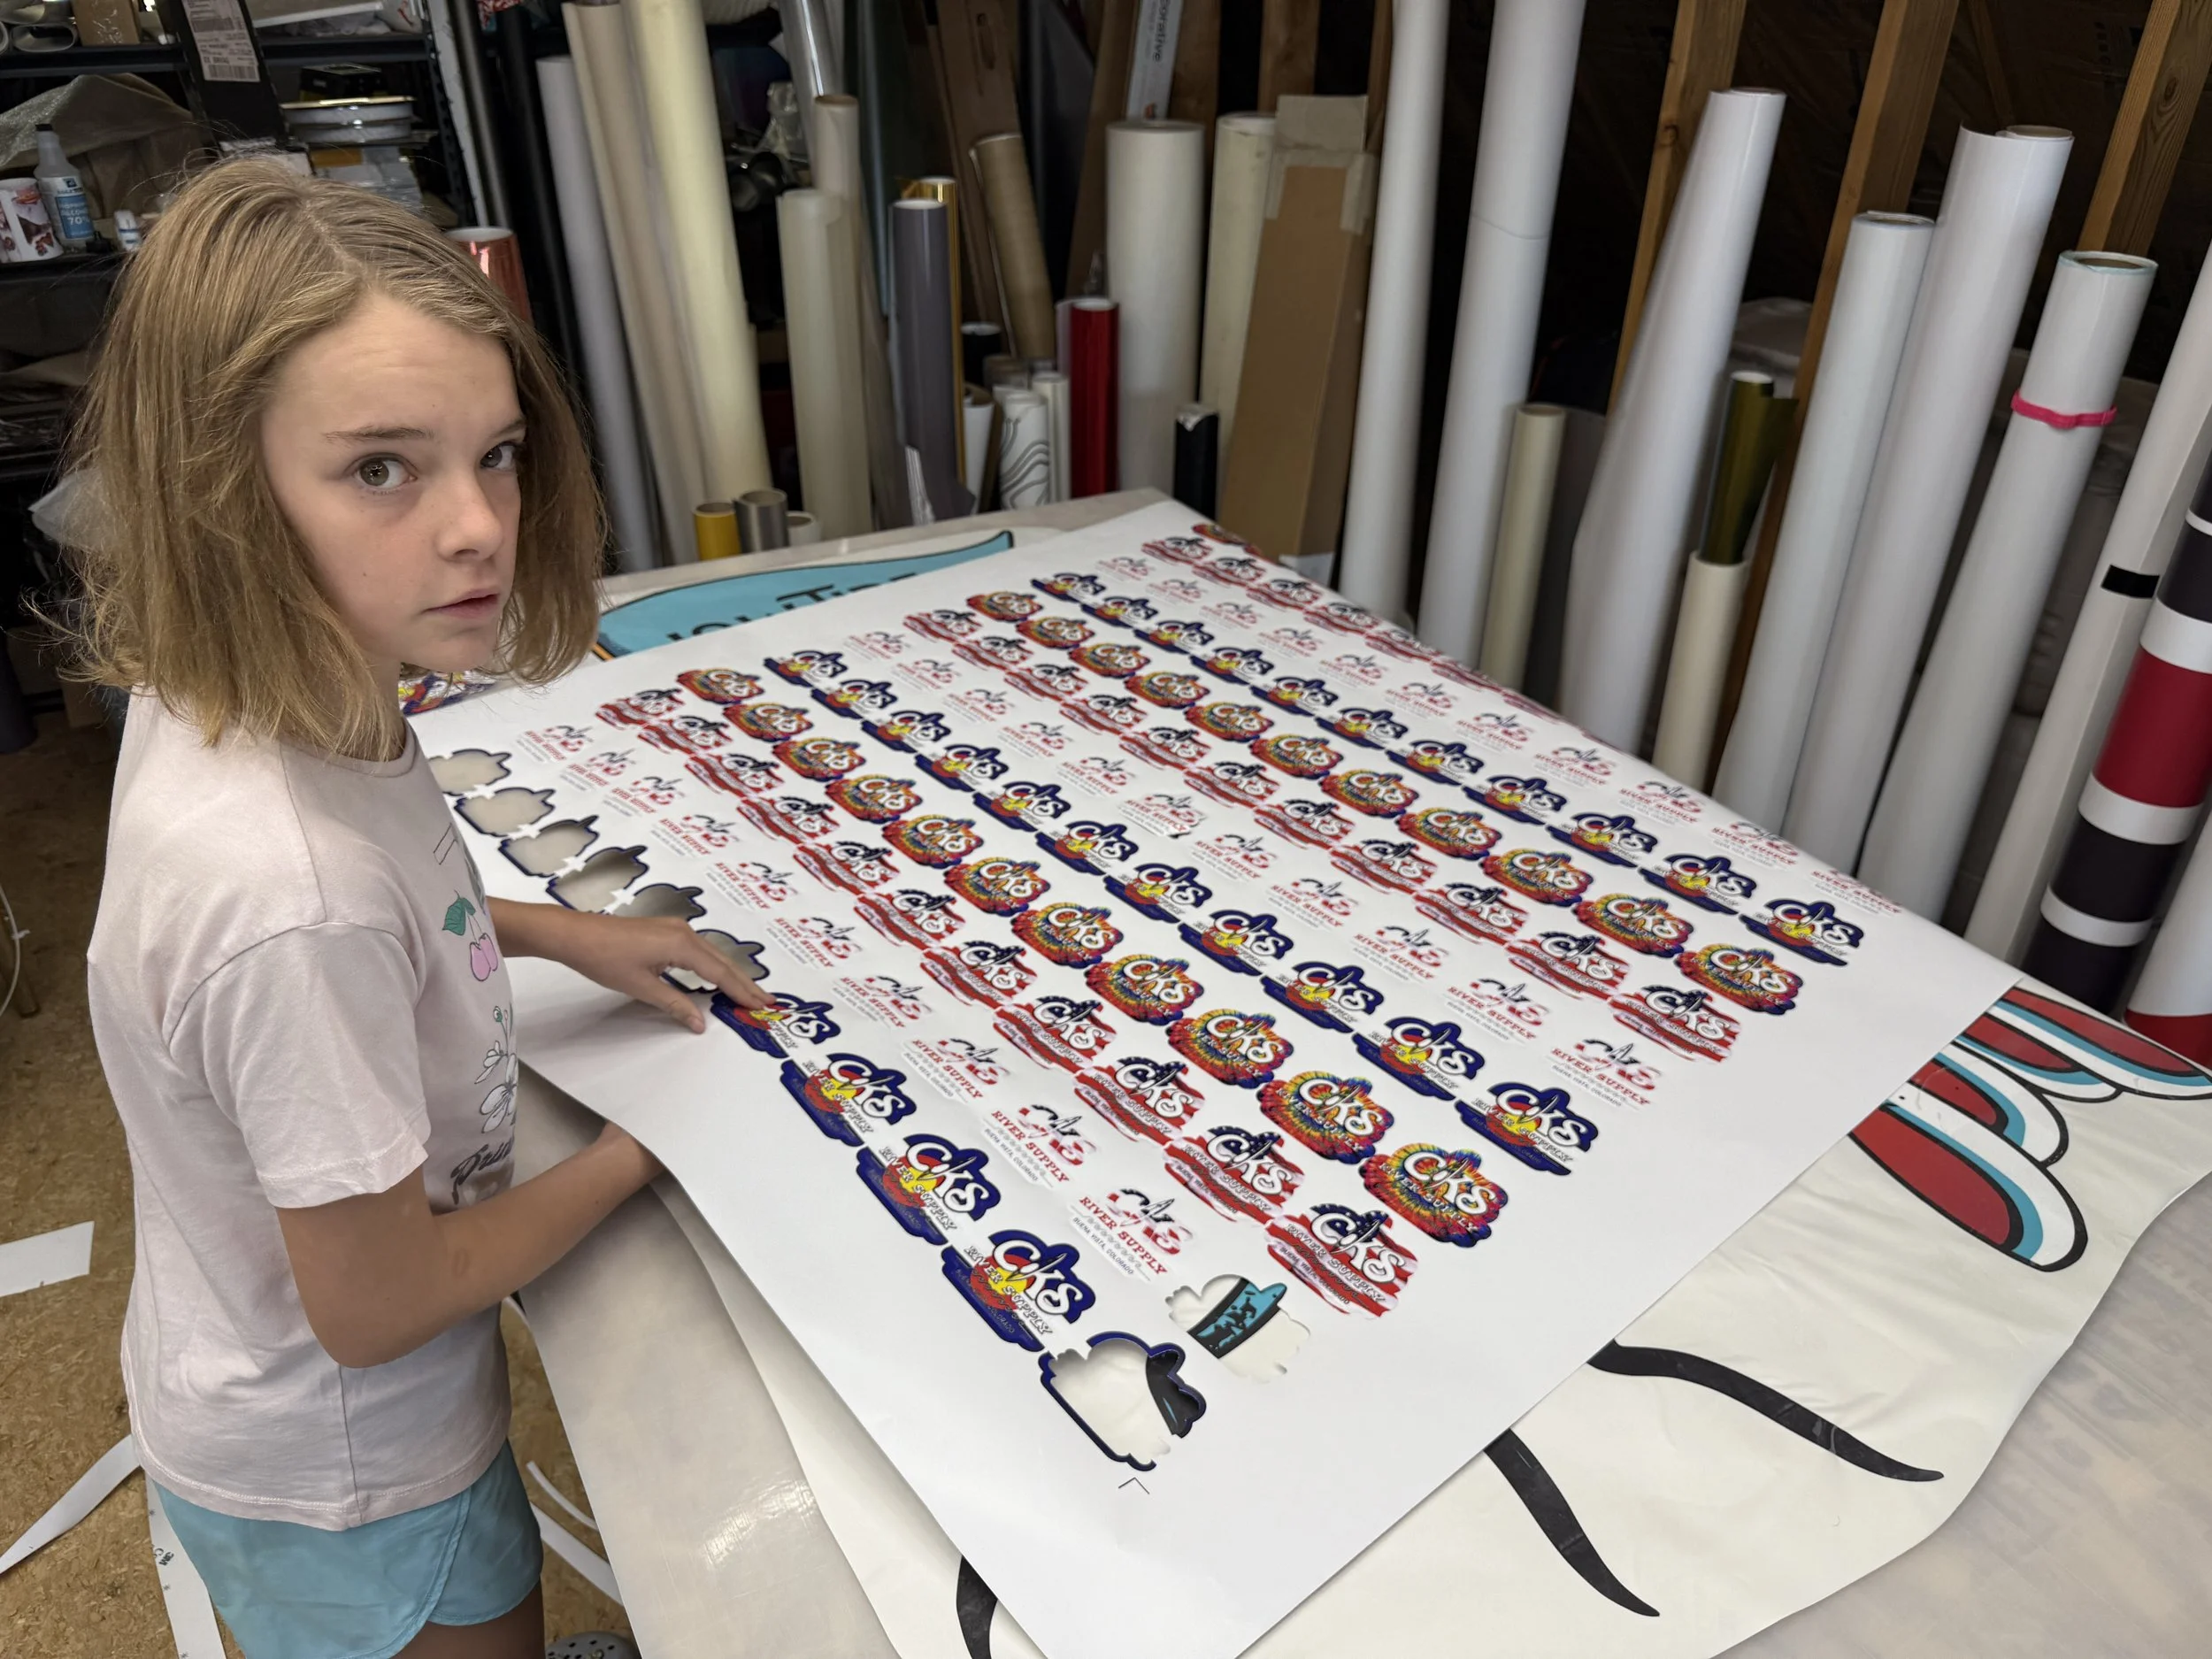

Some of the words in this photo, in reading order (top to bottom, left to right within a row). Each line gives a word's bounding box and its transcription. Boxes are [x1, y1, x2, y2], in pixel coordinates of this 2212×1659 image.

[1672, 858, 1751, 895] CKS
[1215, 915, 1286, 956] CKS
[1603, 897, 1687, 938] CKS
[1774, 904, 1857, 945] CKS
[1121, 957, 1197, 1003] CKS
[1299, 967, 1377, 1010] CKS
[1540, 937, 1624, 981] CKS
[1707, 948, 1797, 993] CKS
[1204, 1013, 1286, 1064] CKS
[1447, 986, 1486, 1010] RIVER
[1486, 1009, 1535, 1041] SUPPLY
[1645, 992, 1737, 1041] CKS
[910, 1040, 944, 1064] RIVER
[940, 1064, 983, 1096] SUPPLY
[1393, 1023, 1477, 1075] CKS
[1550, 1048, 1594, 1074] RIVER
[1594, 1072, 1649, 1108] SUPPLY
[800, 1060, 835, 1093] RIVER
[828, 1092, 872, 1134] SUPPLY
[827, 1059, 908, 1119] CKS
[1115, 1064, 1198, 1119] CKS
[1296, 1076, 1386, 1135] CKS
[1498, 1089, 1591, 1147] CKS
[990, 1109, 1026, 1141] RIVER
[1022, 1141, 1069, 1182] SUPPLY
[1274, 1087, 1315, 1118] RIVER
[1312, 1114, 1364, 1154] SUPPLY
[1471, 1097, 1517, 1128] RIVER
[1515, 1125, 1574, 1164] SUPPLY
[877, 1146, 915, 1184] RIVER
[909, 1182, 956, 1232] SUPPLY
[906, 1142, 993, 1212] CKS
[1207, 1134, 1297, 1197] CKS
[1401, 1148, 1500, 1215] CKS
[1378, 1162, 1423, 1195] RIVER
[1420, 1192, 1479, 1235] SUPPLY
[1071, 1216, 1090, 1233] BUENA
[1102, 1245, 1134, 1273] COLORADO
[1077, 1196, 1118, 1231] RIVER
[1115, 1230, 1166, 1275] SUPPLY
[1282, 1222, 1329, 1259] RIVER
[1326, 1256, 1387, 1305] SUPPLY
[1310, 1213, 1410, 1286] CKS
[962, 1244, 1004, 1285] RIVER
[999, 1284, 1052, 1337] SUPPLY
[993, 1240, 1087, 1315] CKS
